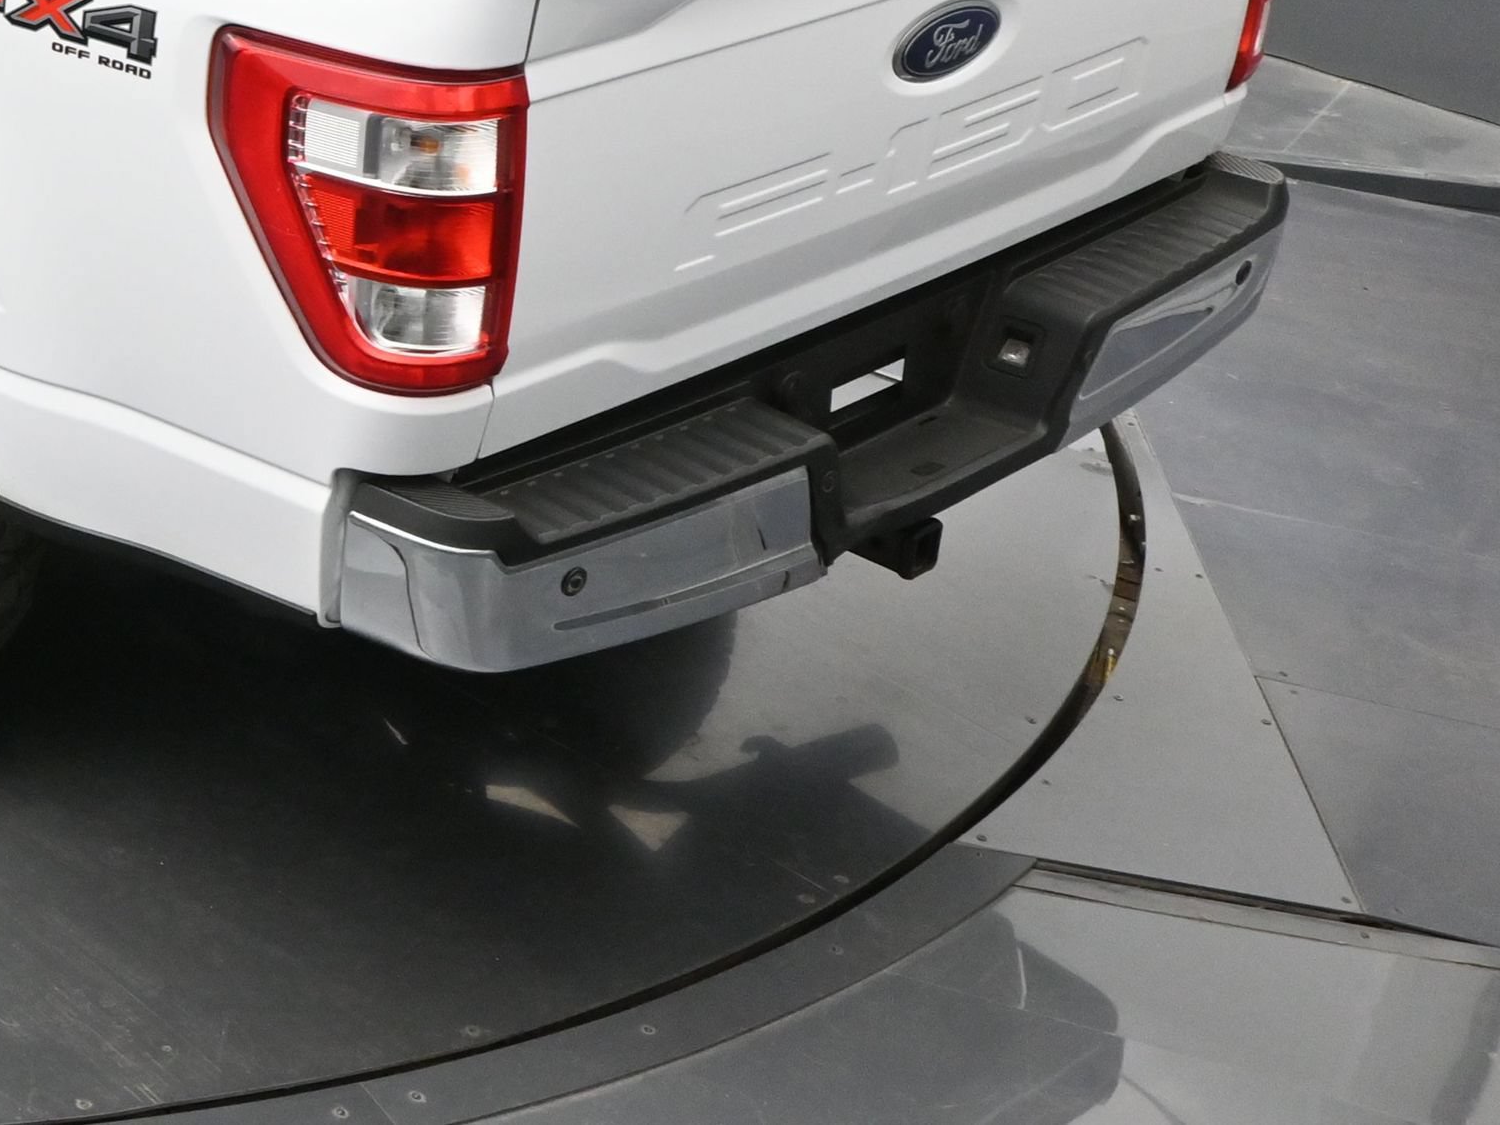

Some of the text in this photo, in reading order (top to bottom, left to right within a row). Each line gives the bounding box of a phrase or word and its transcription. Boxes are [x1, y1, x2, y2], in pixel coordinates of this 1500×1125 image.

[51, 41, 152, 80] OFF ROAD
[924, 18, 984, 69] Ford
[675, 36, 1149, 271] F-150
